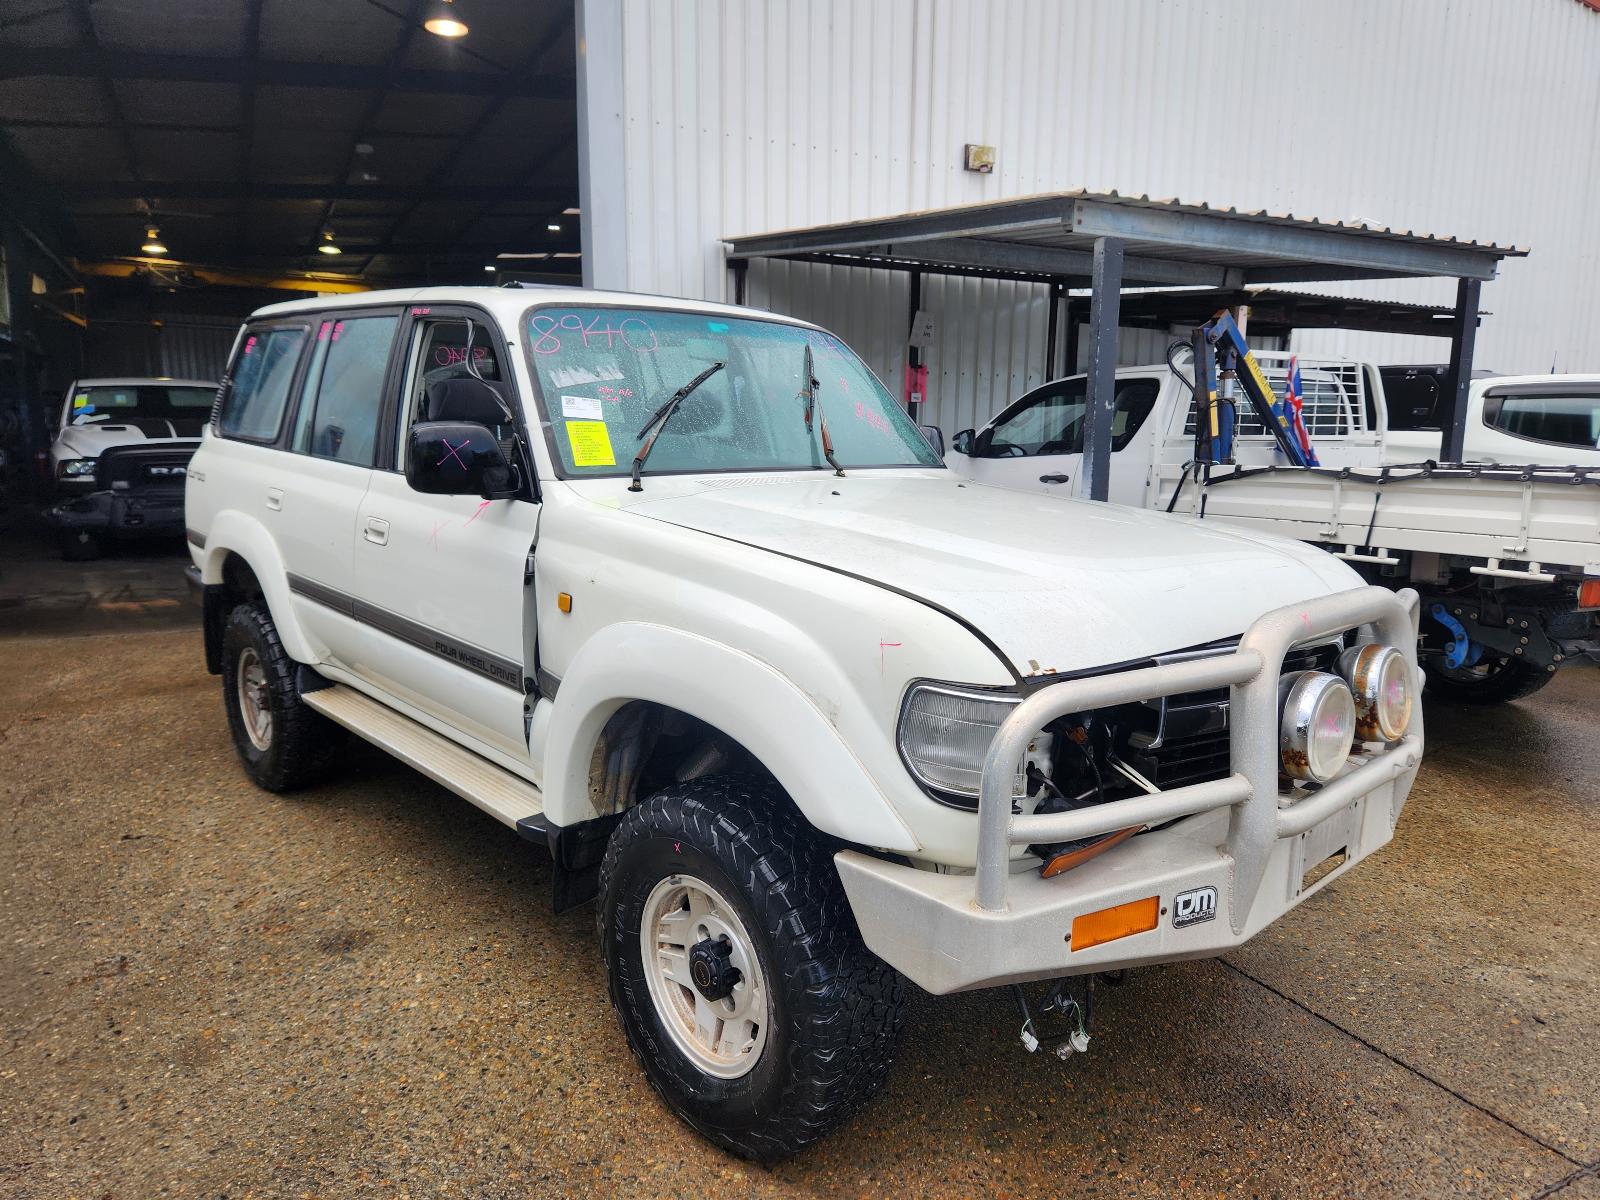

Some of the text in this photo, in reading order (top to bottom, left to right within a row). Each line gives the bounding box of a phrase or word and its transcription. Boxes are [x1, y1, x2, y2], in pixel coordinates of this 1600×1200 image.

[531, 314, 659, 354] 8940
[150, 467, 188, 475] RA
[435, 641, 518, 684] FOUR WHEEL DRIVE
[1174, 907, 1216, 923] PRODUCTS
[1176, 888, 1216, 917] TJM
